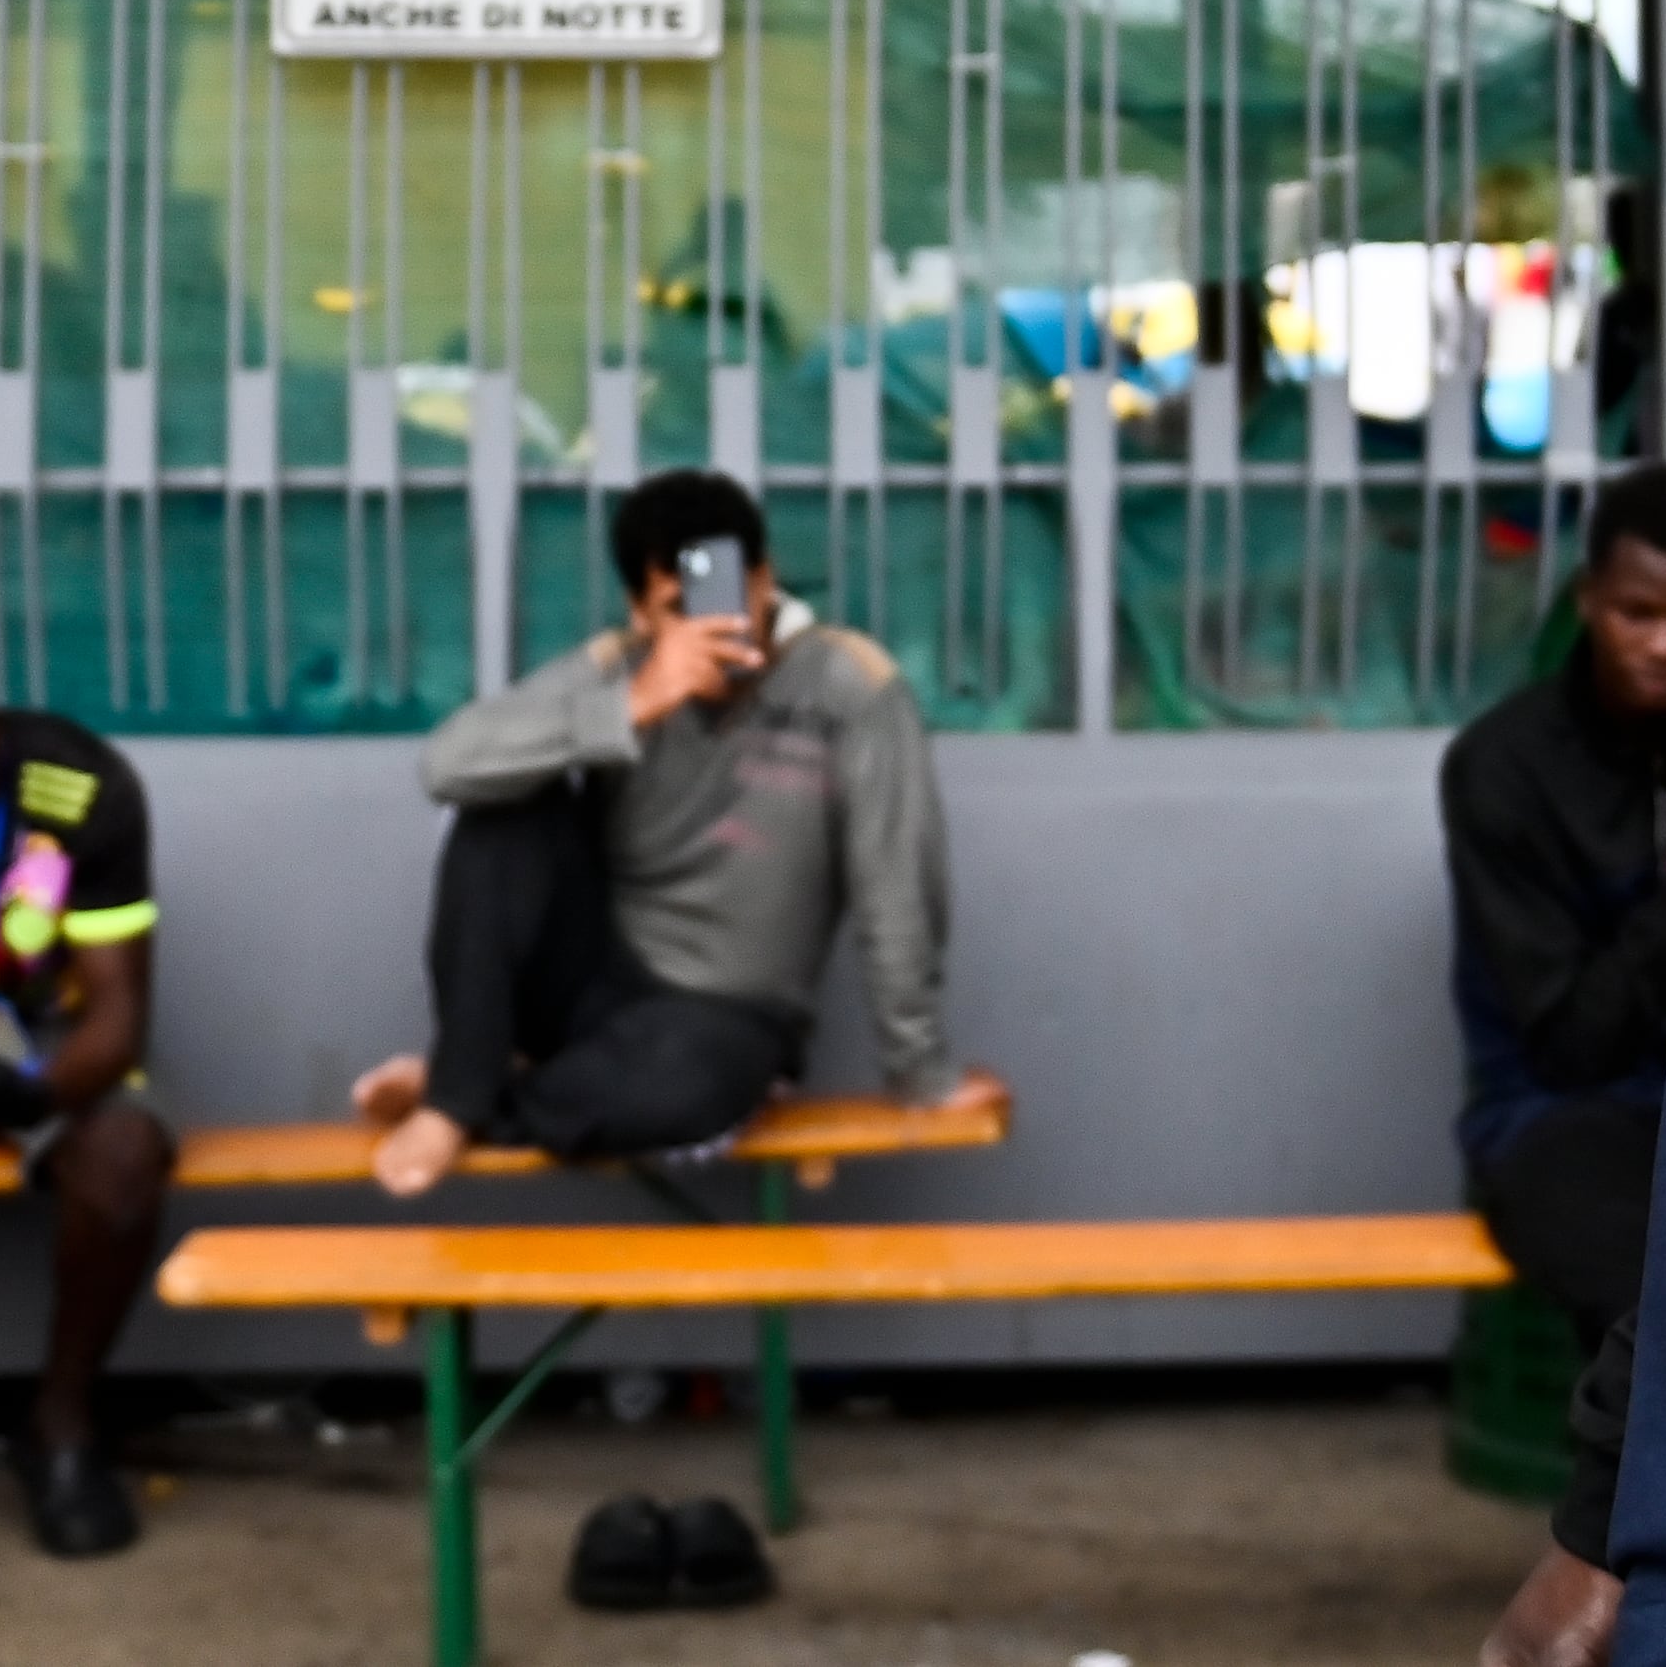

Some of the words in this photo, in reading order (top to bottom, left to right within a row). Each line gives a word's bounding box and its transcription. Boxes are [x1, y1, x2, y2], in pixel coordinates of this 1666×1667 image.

[312, 1, 462, 30] ANCHE
[482, 1, 523, 30] DI
[541, 1, 687, 31] NOTTE
